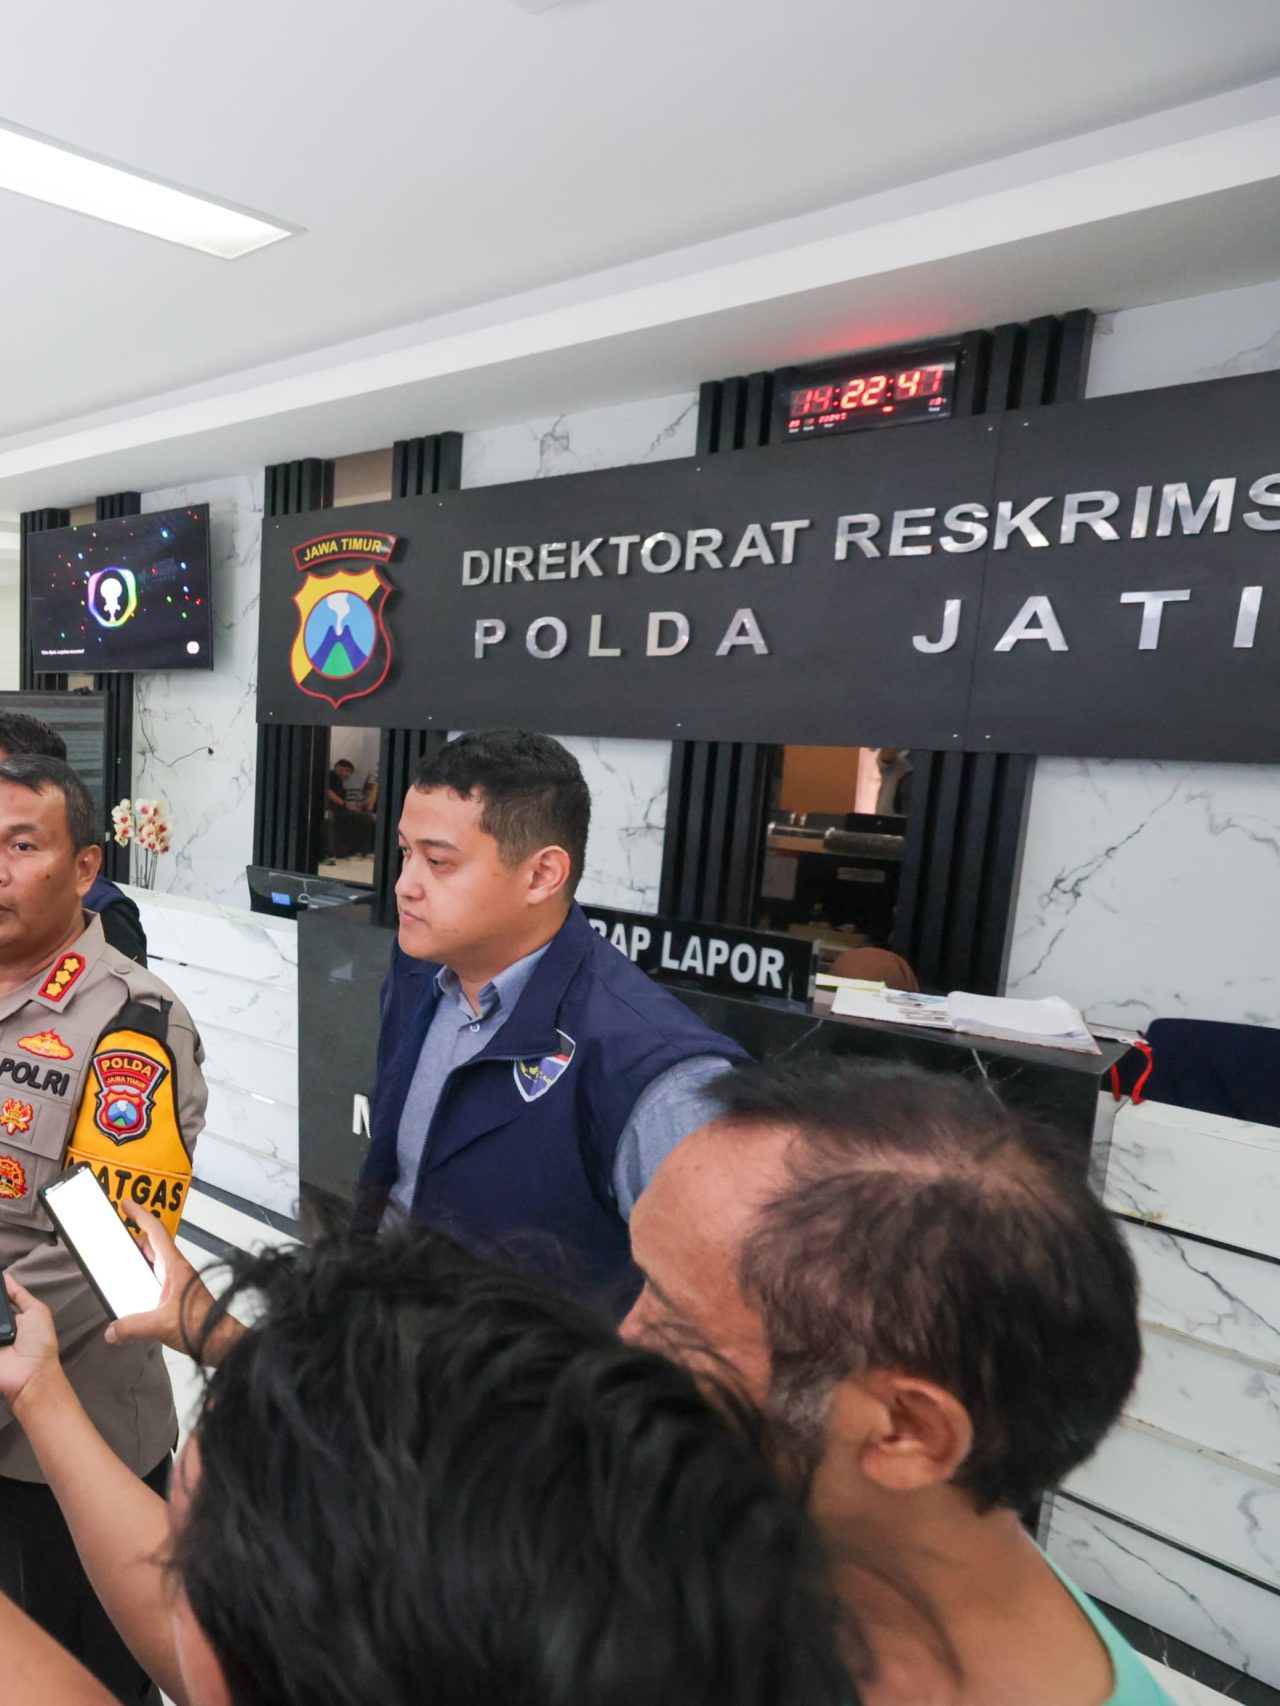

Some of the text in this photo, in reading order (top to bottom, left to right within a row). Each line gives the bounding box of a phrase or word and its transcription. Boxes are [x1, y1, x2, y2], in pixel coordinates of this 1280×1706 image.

[800, 364, 945, 415] 14:22:47
[303, 537, 383, 562] JAWA TIMUR
[461, 472, 1280, 587] DIREKTORAT RESKRIMS
[474, 585, 1264, 660] POLDA JATI
[661, 930, 785, 990] LAPOR
[100, 1057, 152, 1078] POLDA
[107, 1075, 146, 1089] JAWA TIMUR
